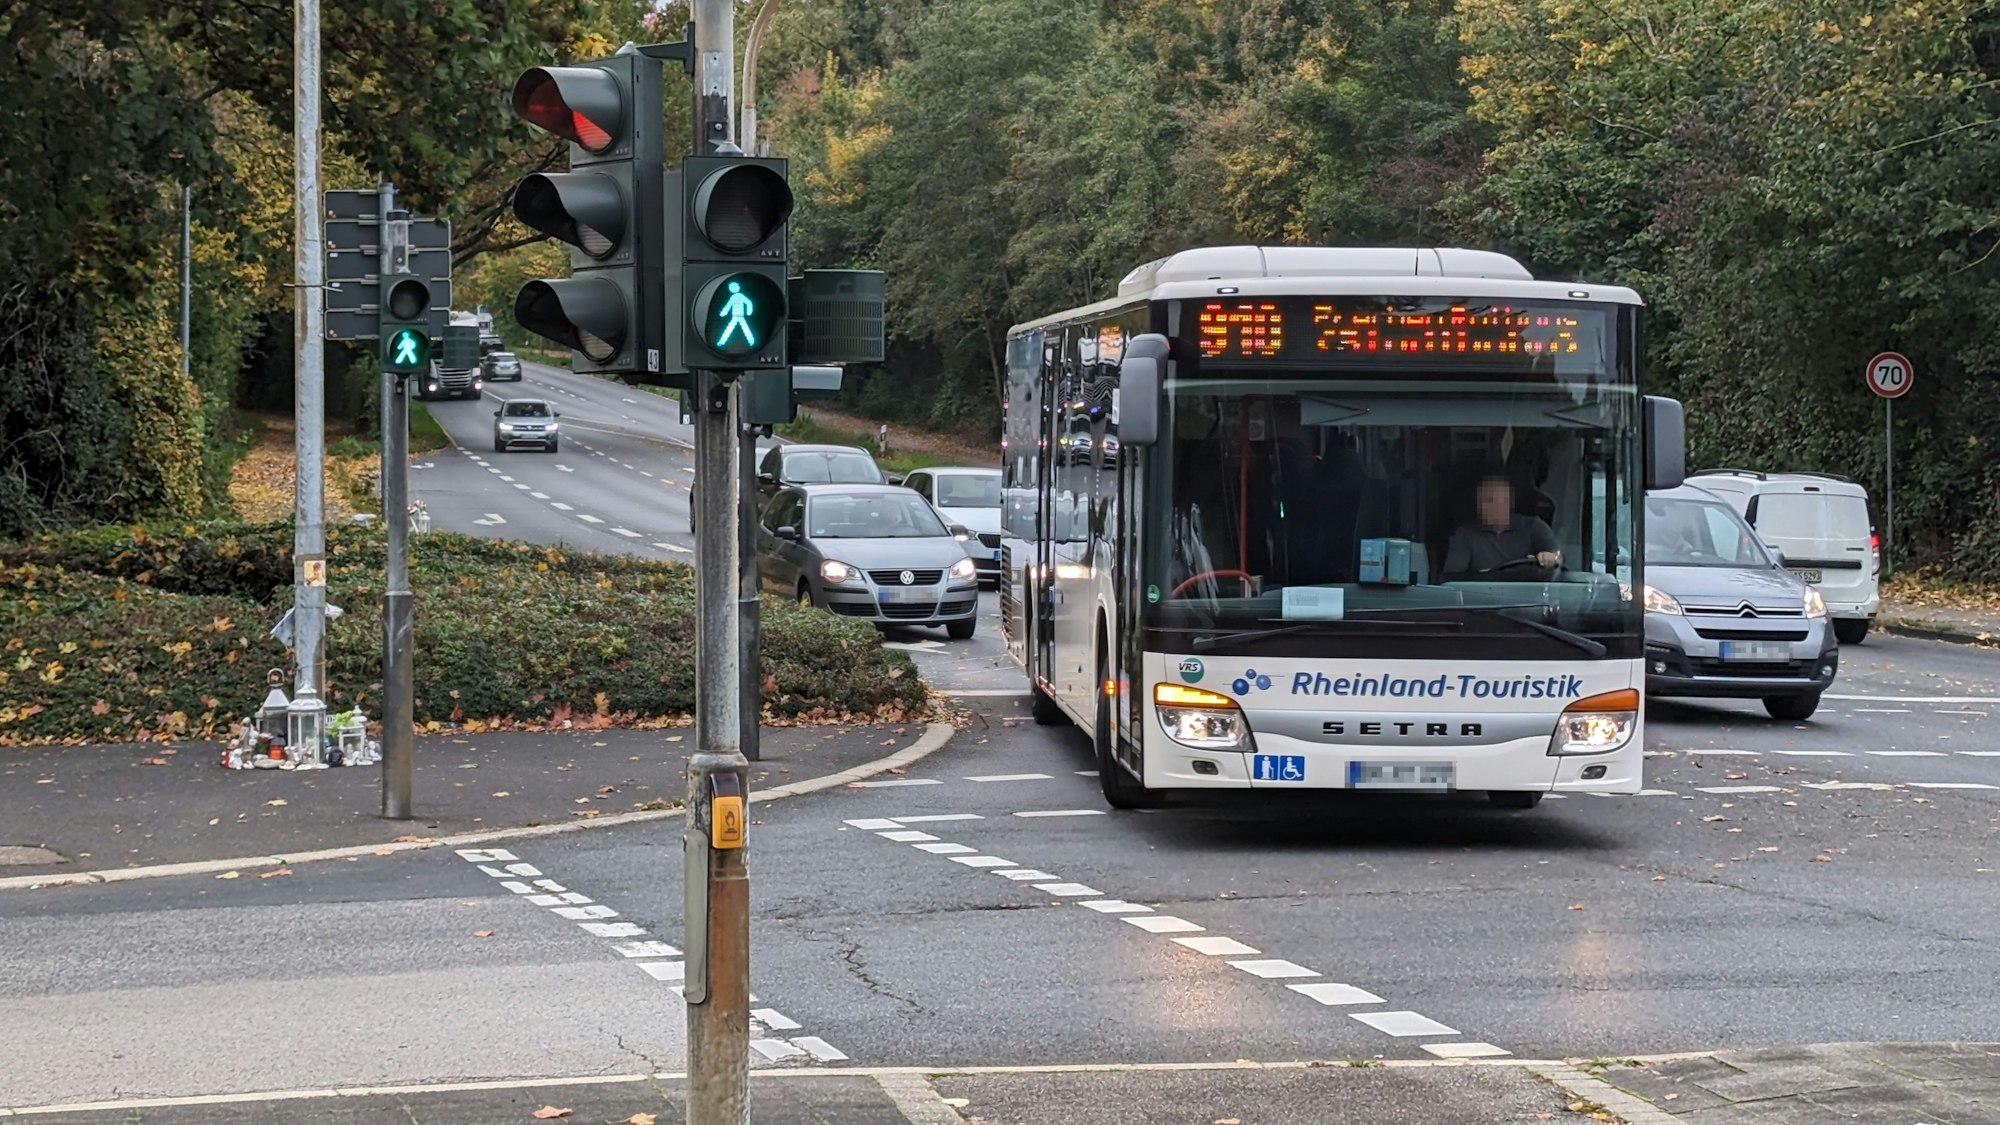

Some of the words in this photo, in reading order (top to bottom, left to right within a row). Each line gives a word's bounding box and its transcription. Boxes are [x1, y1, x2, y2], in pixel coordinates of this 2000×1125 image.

[1878, 365, 1902, 385] 70
[1178, 662, 1198, 672] VRS
[1291, 671, 1583, 698] Rheinland-Touristik
[1322, 721, 1483, 737] SETRA
